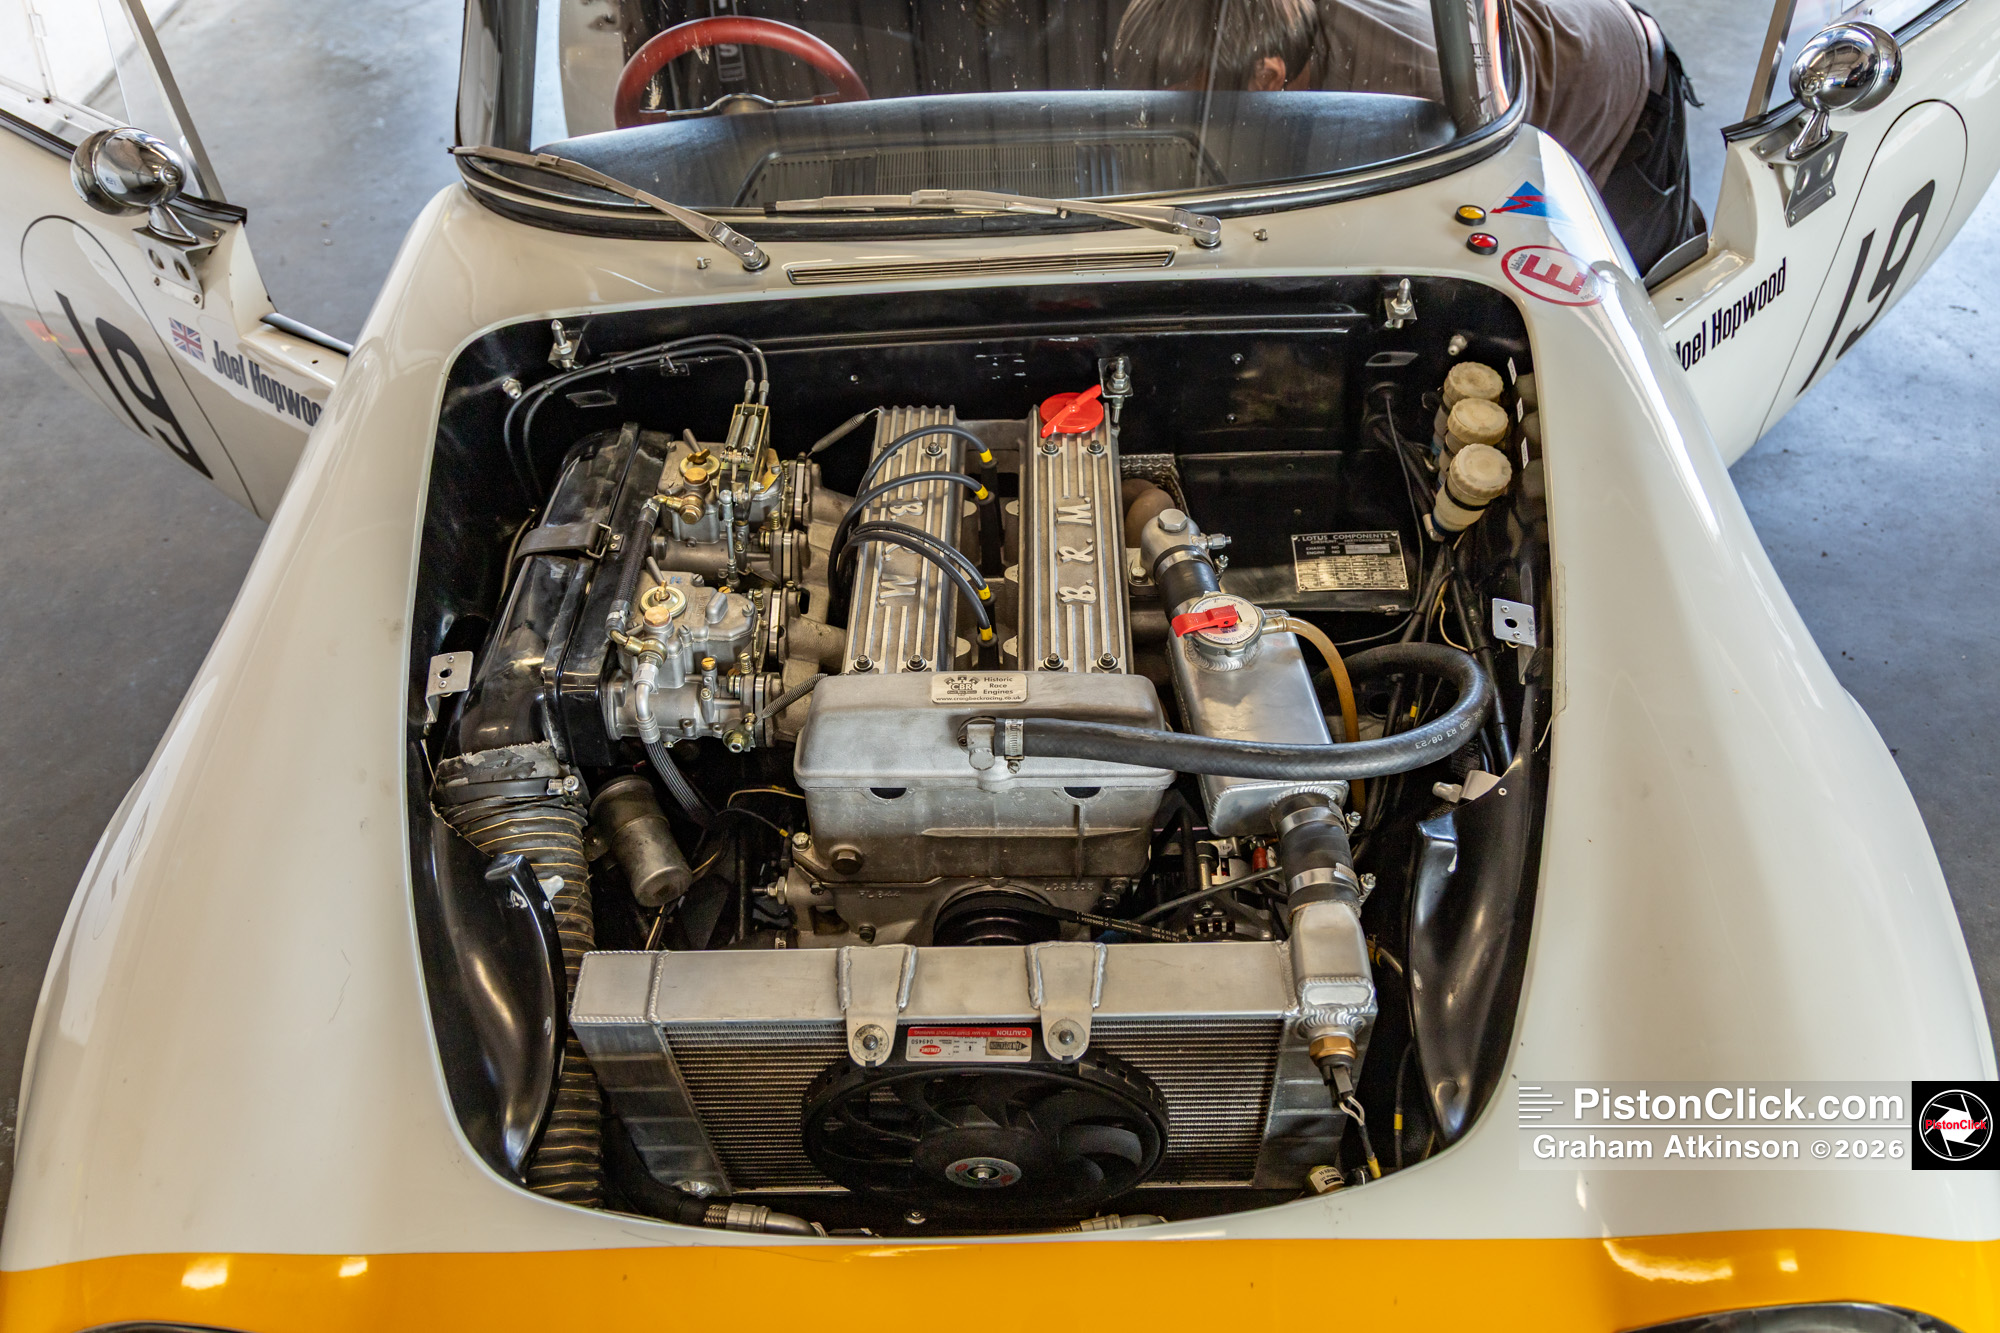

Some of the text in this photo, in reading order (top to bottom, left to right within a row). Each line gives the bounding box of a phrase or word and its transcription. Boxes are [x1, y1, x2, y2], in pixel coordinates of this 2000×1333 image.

[1519, 254, 1589, 296] E
[1711, 256, 1787, 350] Hopwood
[1795, 179, 1936, 399] 19
[55, 289, 214, 481] 19
[212, 339, 323, 427] Joel Hopwoo
[950, 683, 973, 691] CBR
[1415, 734, 1443, 749] 08/23
[1446, 727, 1458, 738] R3
